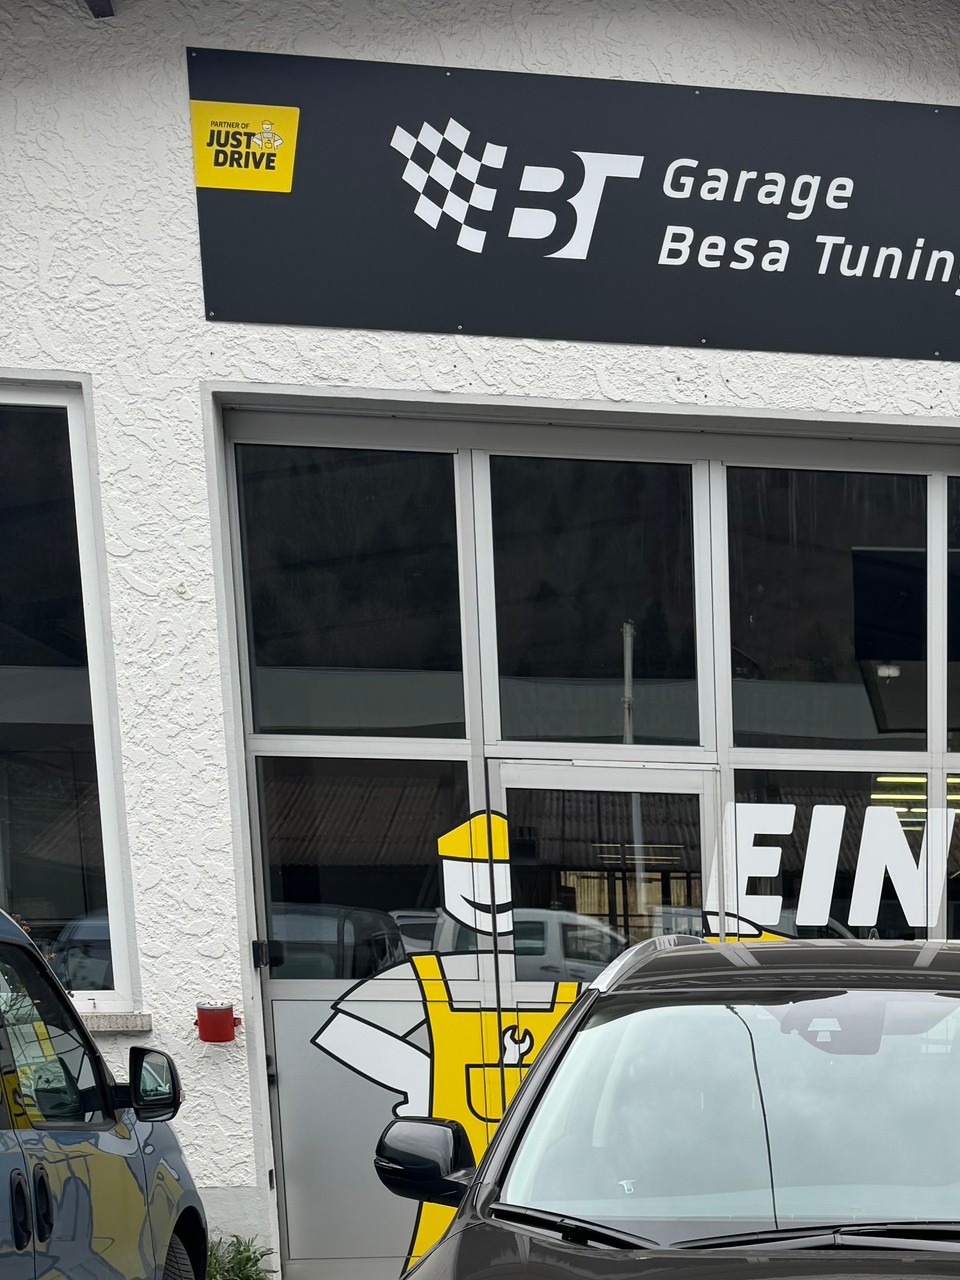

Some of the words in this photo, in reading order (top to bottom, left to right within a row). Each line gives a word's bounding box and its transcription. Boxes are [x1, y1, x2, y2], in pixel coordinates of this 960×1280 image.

[206, 129, 256, 150] JUST
[210, 120, 240, 129] PARTNER
[241, 122, 250, 130] OF
[213, 148, 277, 171] DRIVE
[662, 157, 855, 221] Garage
[657, 225, 790, 272] Besa
[703, 802, 956, 928] EIN
